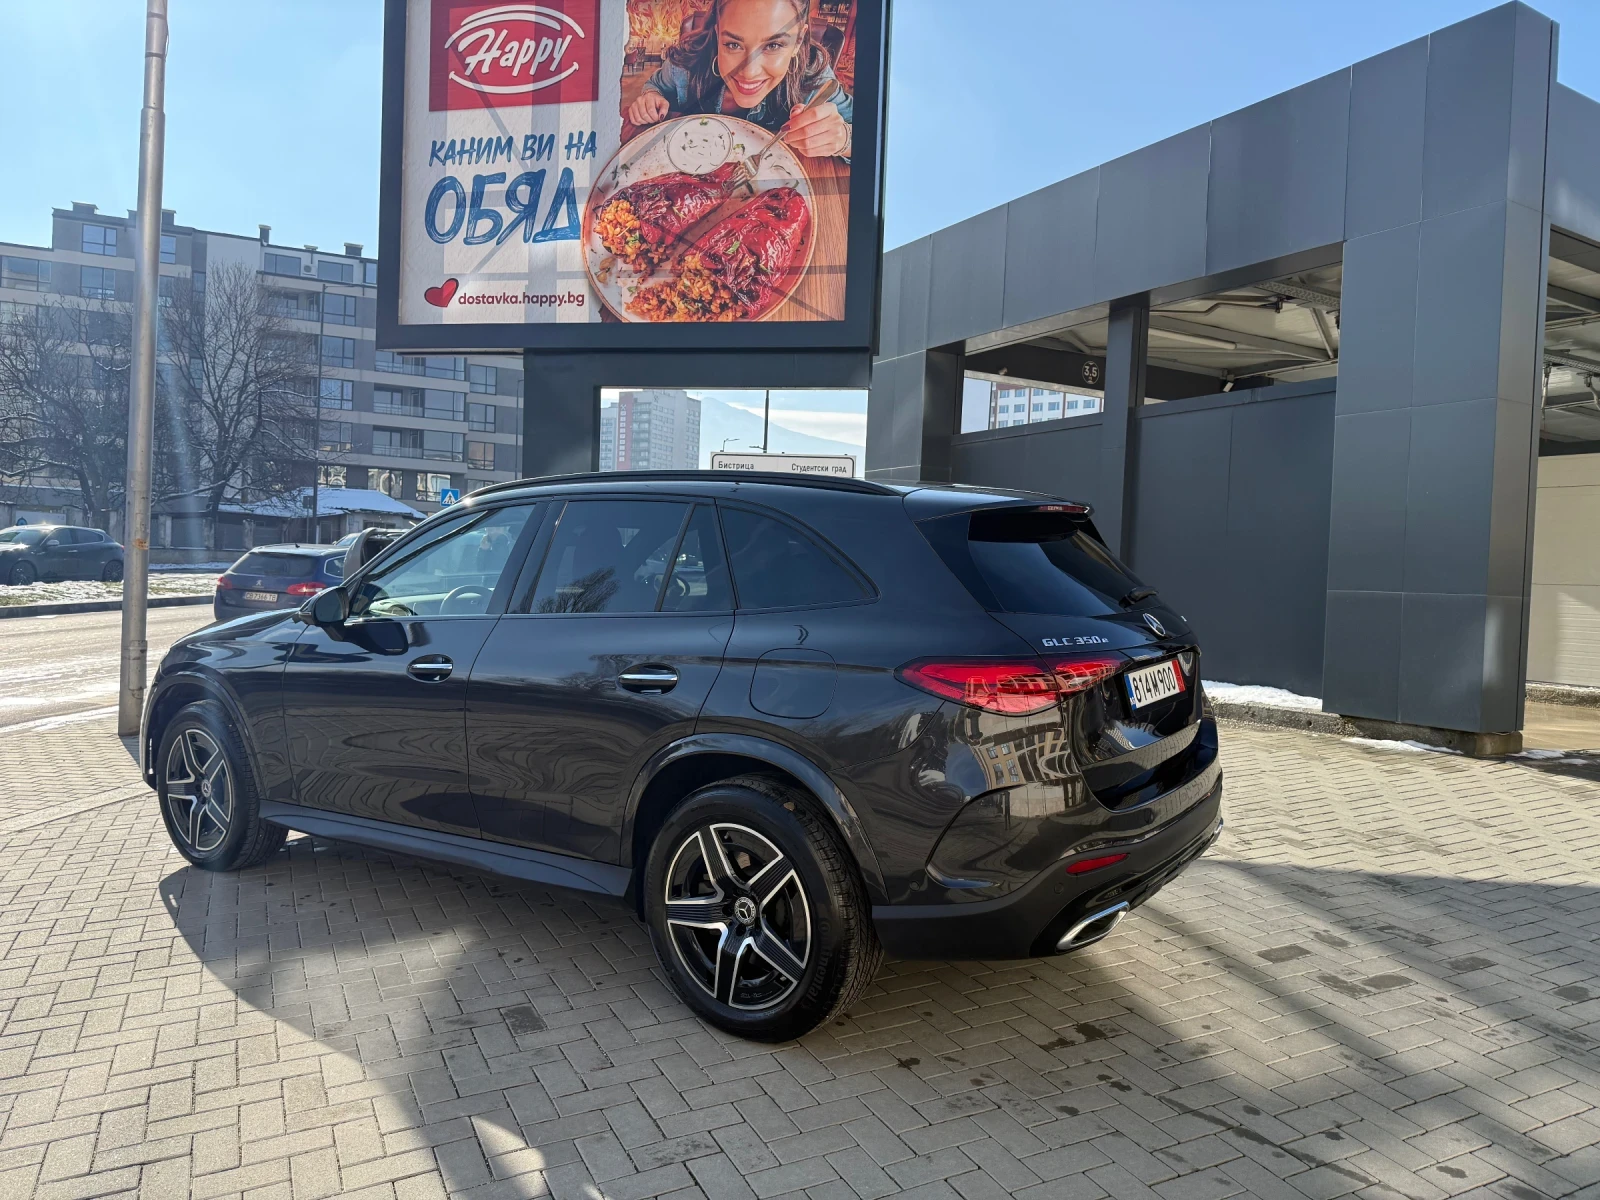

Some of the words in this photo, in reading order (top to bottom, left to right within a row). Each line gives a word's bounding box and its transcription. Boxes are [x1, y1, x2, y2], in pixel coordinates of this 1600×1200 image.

[458, 28, 572, 77] Happy
[429, 135, 514, 167] КАНИМ
[521, 133, 556, 161] ВИ
[565, 130, 597, 160] НА
[424, 167, 581, 246] ОБЯД
[458, 291, 585, 307] dostavka.happy.bg
[1084, 365, 1098, 377] 3.5
[718, 460, 754, 470] Бистрица
[791, 463, 829, 473] Студентски
[831, 465, 847, 473] град
[1042, 637, 1074, 647] GLC
[1074, 635, 1110, 646] 350e
